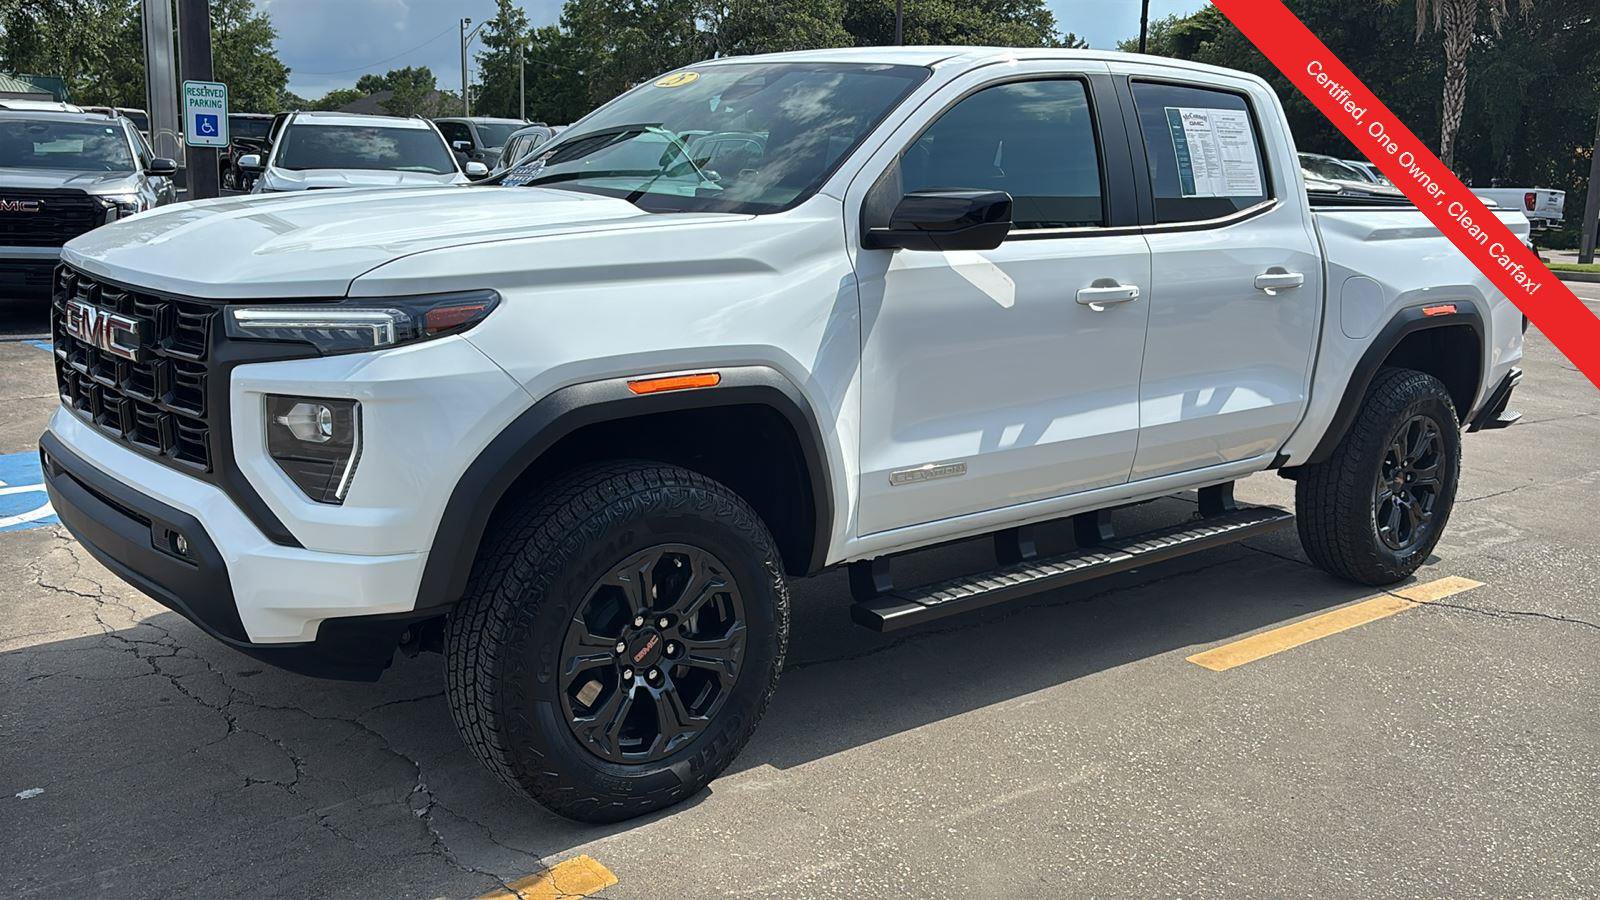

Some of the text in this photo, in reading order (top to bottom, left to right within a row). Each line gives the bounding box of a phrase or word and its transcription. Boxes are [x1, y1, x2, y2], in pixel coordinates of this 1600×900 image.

[186, 87, 224, 98] RESERVED
[190, 98, 223, 109] PARKING
[0, 200, 39, 212] MC
[65, 300, 139, 361] GMC
[896, 464, 963, 480] ELEVATION
[634, 634, 659, 662] GMC
